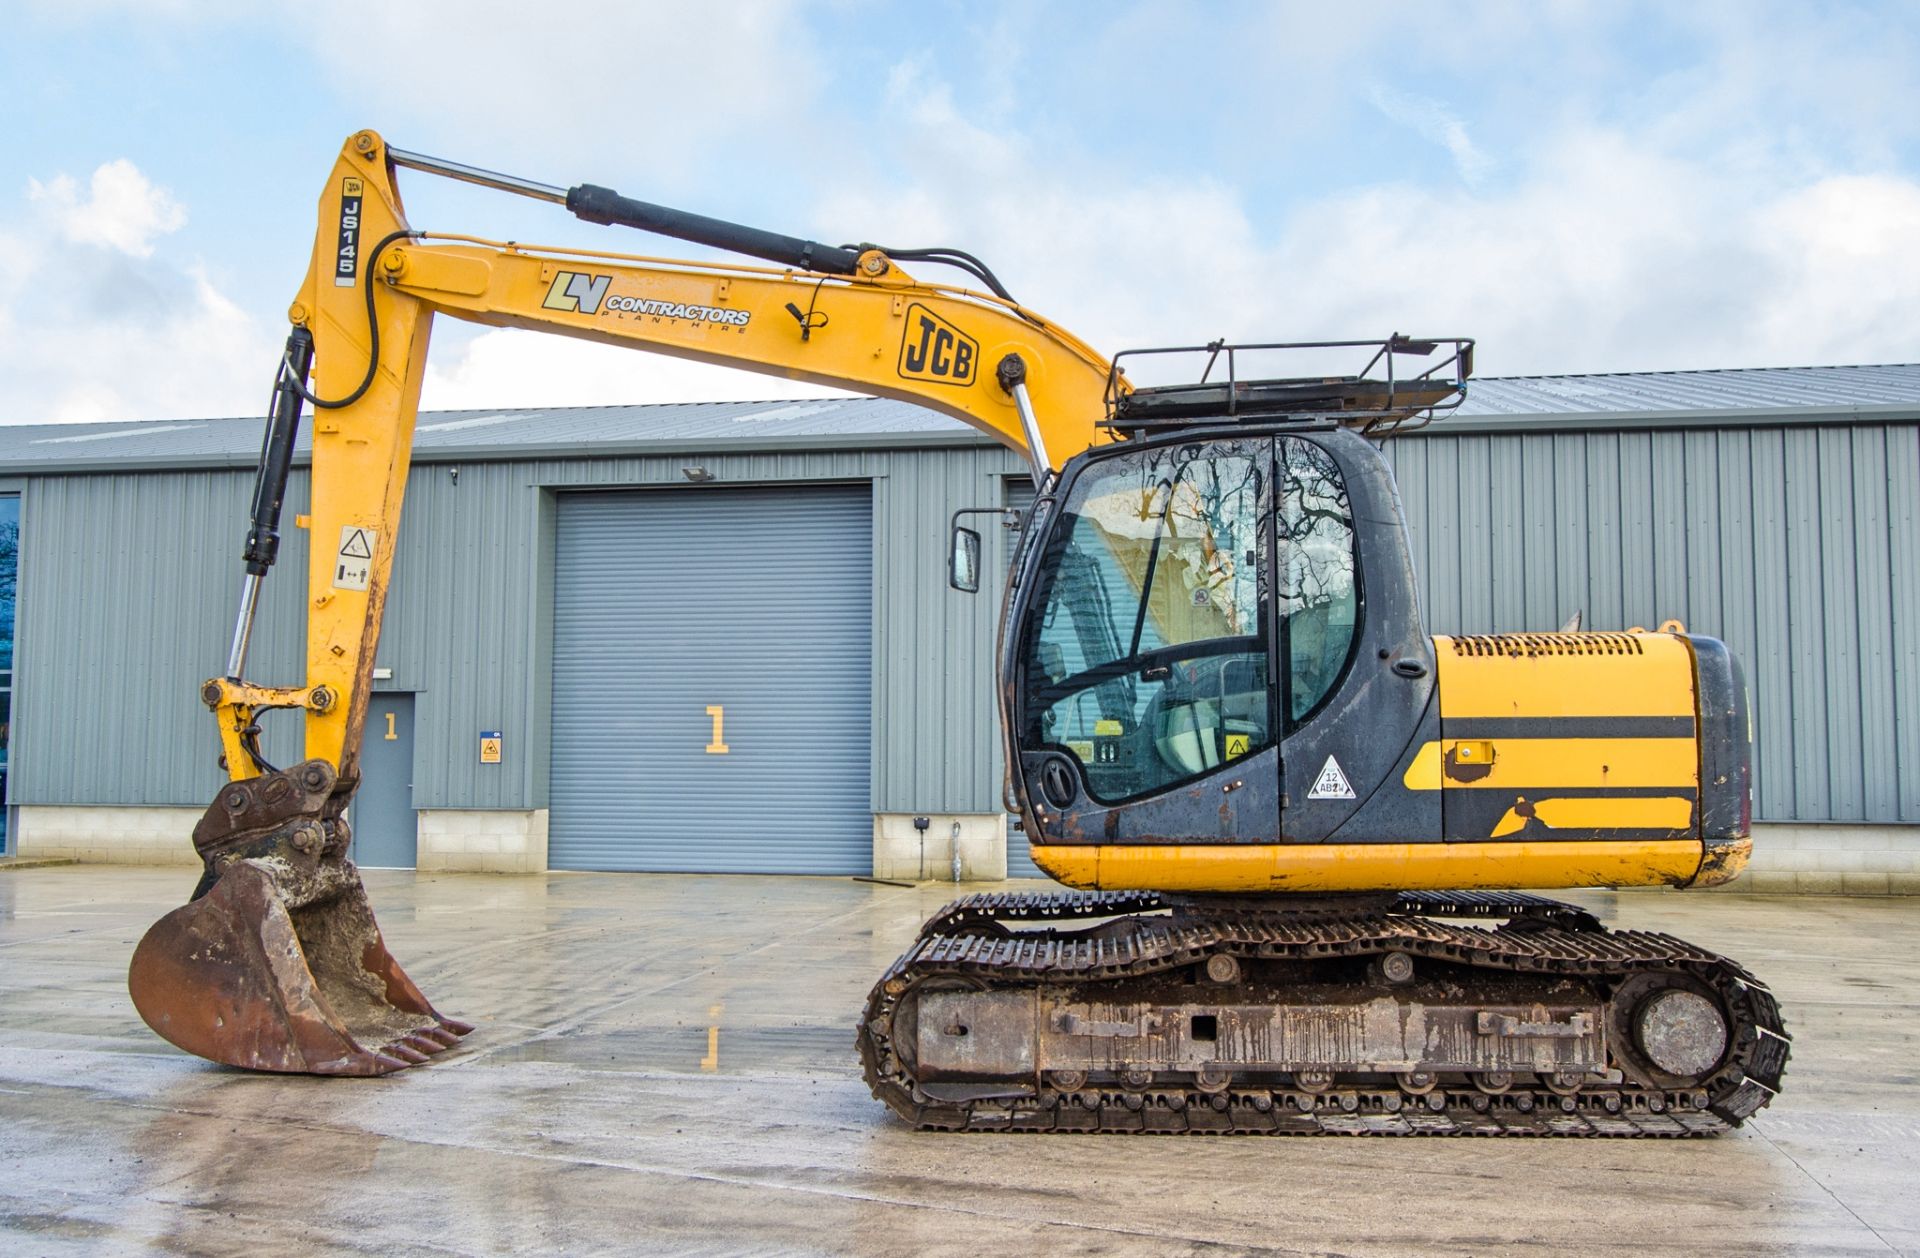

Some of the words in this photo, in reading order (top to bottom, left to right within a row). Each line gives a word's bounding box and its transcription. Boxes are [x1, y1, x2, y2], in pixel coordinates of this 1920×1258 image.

[339, 202, 358, 273] JS145
[601, 310, 677, 326] PLANT
[691, 322, 746, 334] HIRE
[605, 295, 750, 325] CONTRACTORS
[906, 315, 972, 379] JCB
[385, 713, 397, 740] 1
[705, 705, 729, 753] 1
[1325, 773, 1338, 782] 12
